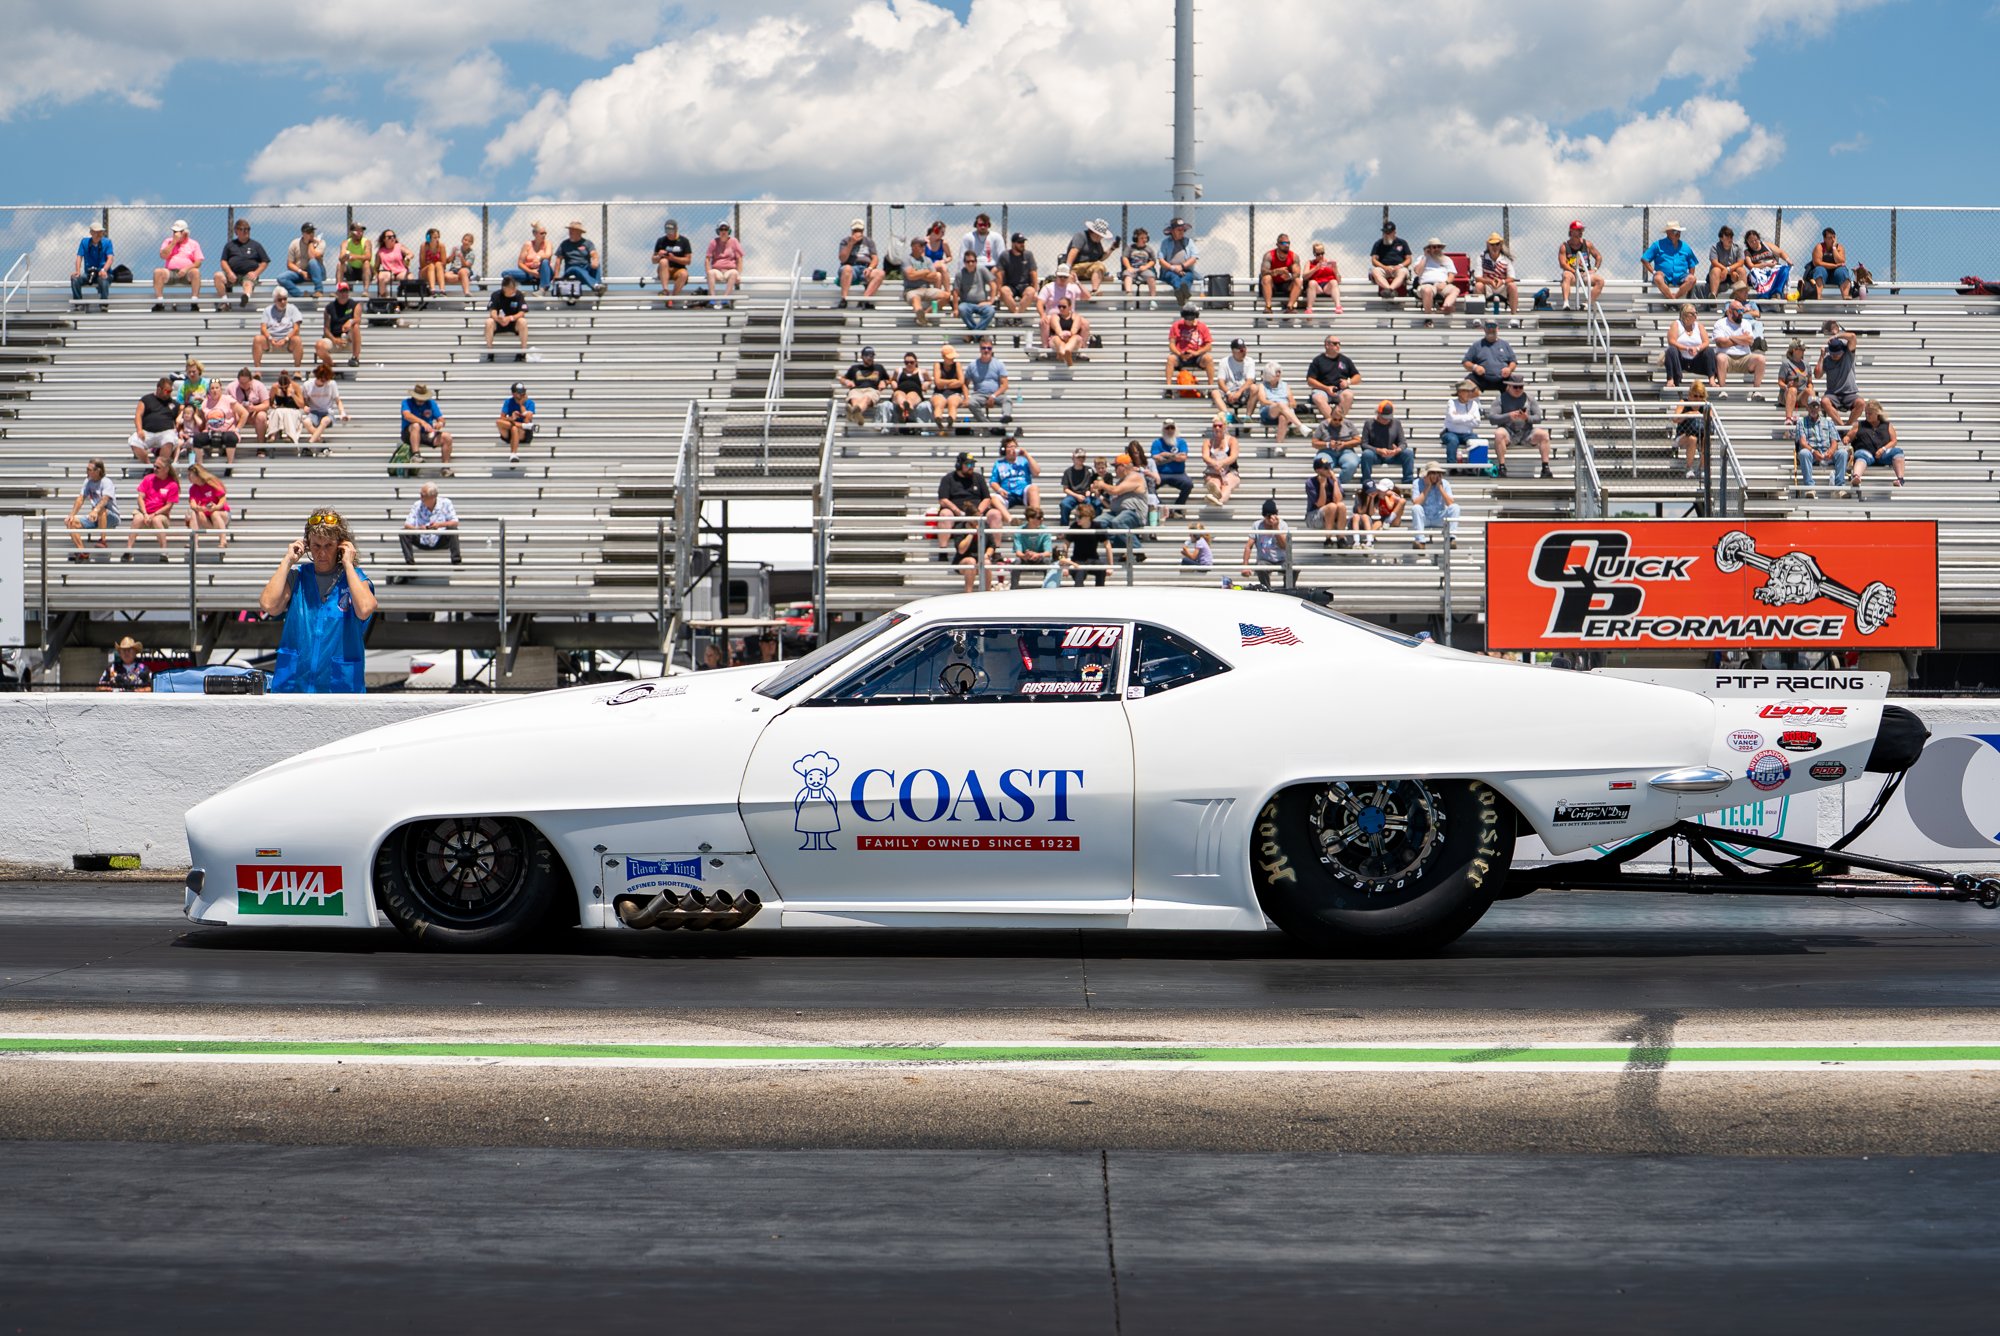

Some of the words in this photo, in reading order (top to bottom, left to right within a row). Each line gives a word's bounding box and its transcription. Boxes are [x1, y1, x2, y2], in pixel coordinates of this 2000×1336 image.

[1529, 530, 1698, 588] QUICK
[1541, 583, 1847, 641] PERFORMANCE
[1061, 626, 1122, 648] 1078
[1021, 682, 1101, 693] GUSTAFSON/LEE
[1716, 676, 1769, 689] PTP
[1751, 771, 1785, 781] IHRA
[1812, 766, 1844, 775] PDRA
[850, 768, 1084, 823] COAST
[865, 838, 919, 848] FAMILY
[927, 838, 980, 848] OWNED
[988, 839, 1032, 848] SINCE
[1040, 839, 1073, 848] 1922
[629, 860, 657, 876] Flavor
[673, 862, 697, 877] King
[256, 870, 325, 906] VIVA
[627, 881, 656, 893] REFINED
